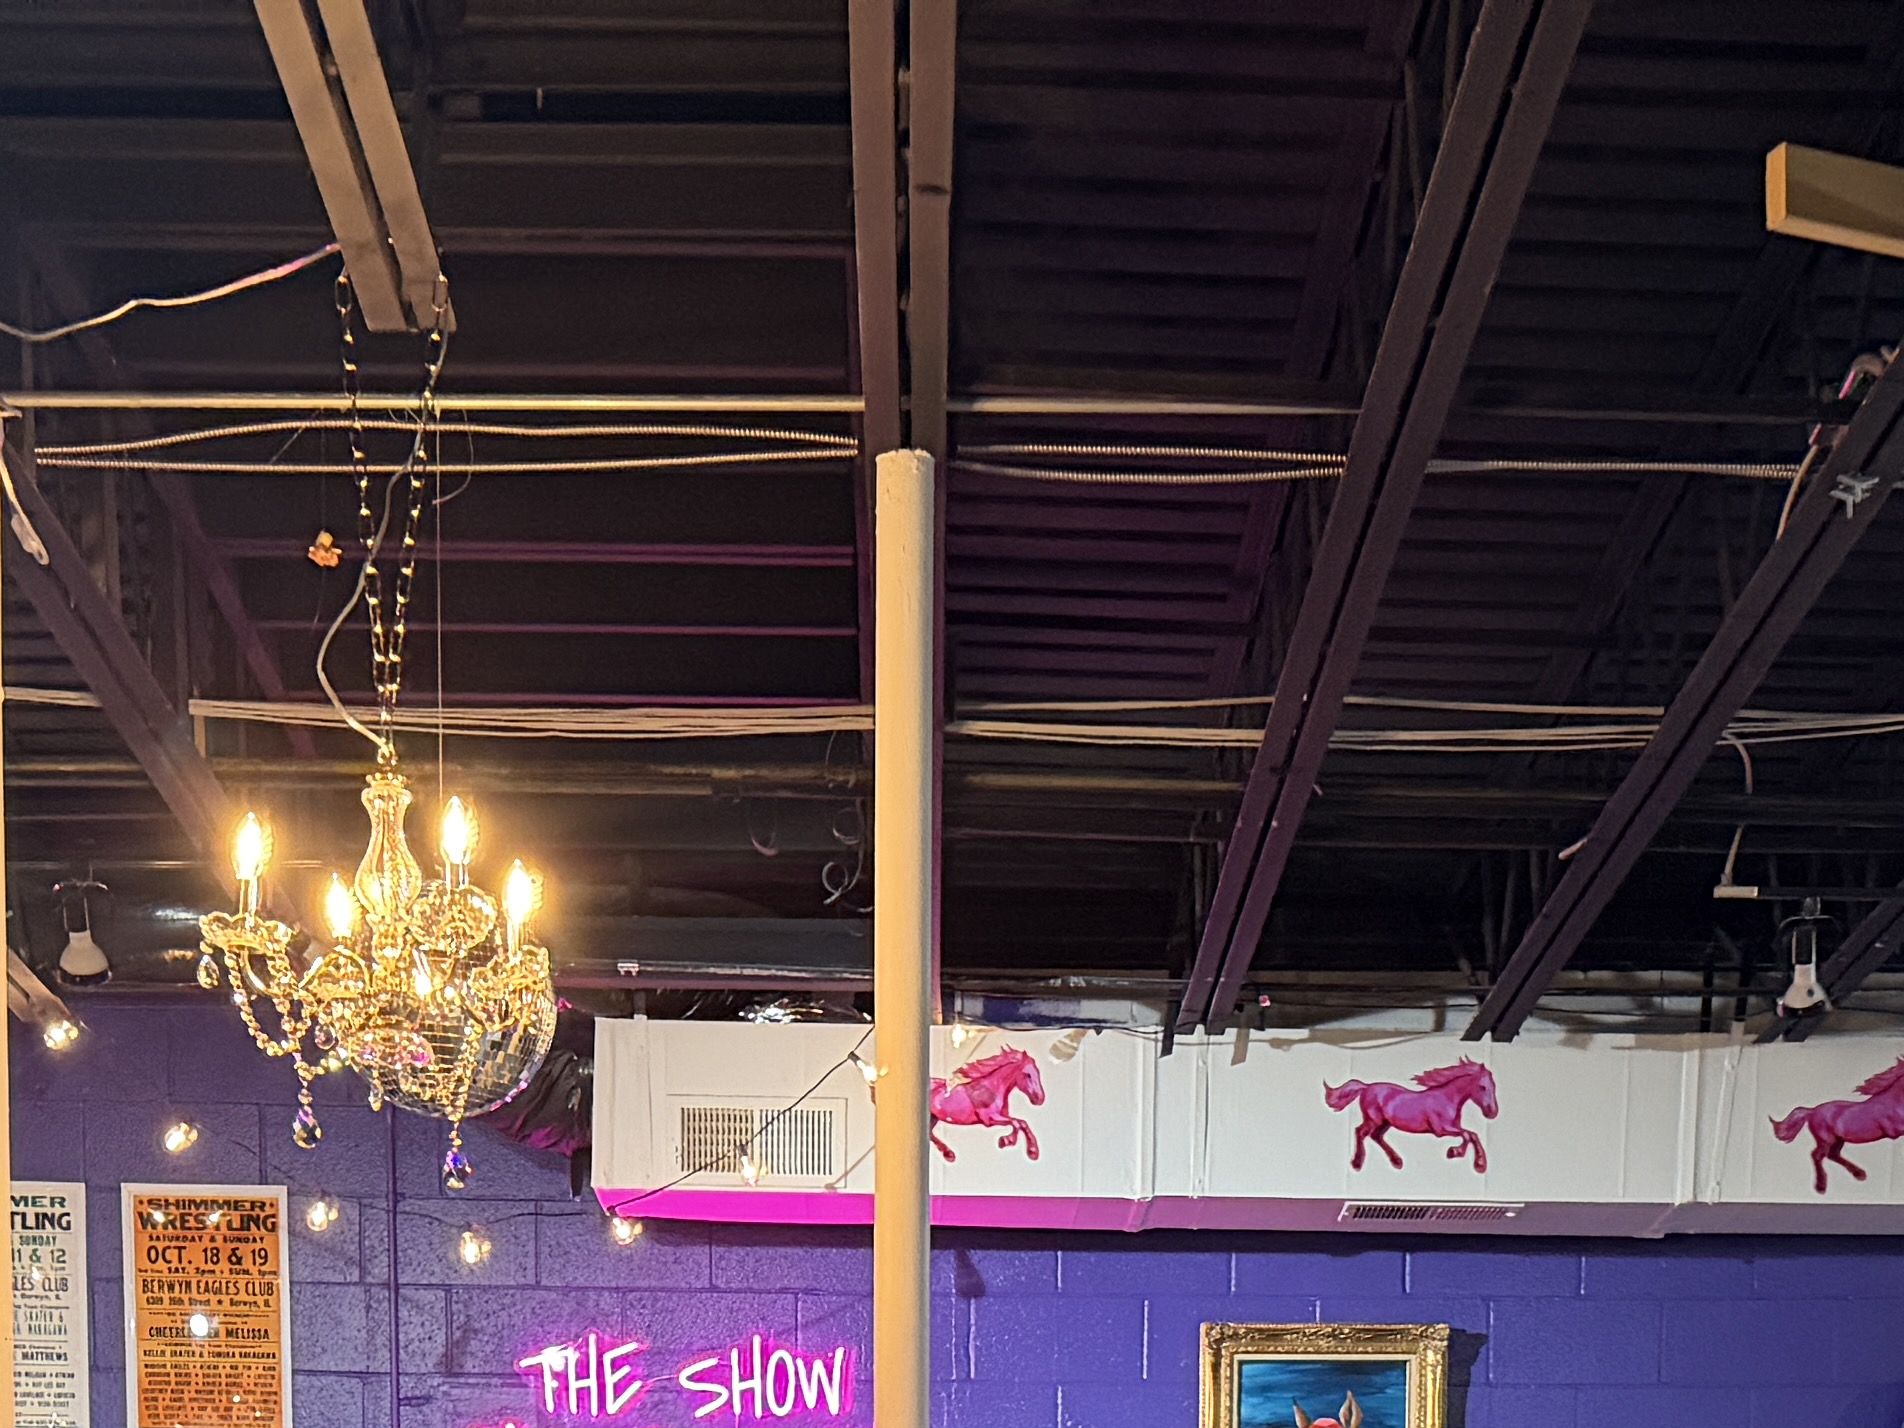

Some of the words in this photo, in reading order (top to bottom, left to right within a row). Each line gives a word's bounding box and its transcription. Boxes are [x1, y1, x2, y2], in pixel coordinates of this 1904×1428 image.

[147, 1198, 266, 1212] SHIMMER
[19, 1235, 57, 1247] SUNDAY
[148, 1234, 204, 1243] SATURDAY
[209, 1235, 217, 1243] &
[223, 1235, 265, 1244] SUNDAY
[29, 1248, 41, 1263] &
[50, 1249, 67, 1264] 12
[147, 1245, 193, 1265] OCT.
[202, 1247, 220, 1265] 18
[227, 1247, 243, 1266] &
[250, 1247, 269, 1267] 19
[42, 1277, 69, 1292] CLUB
[142, 1279, 192, 1295] BERWYN
[197, 1279, 240, 1296] EAGLES
[245, 1280, 274, 1297] CLUB
[225, 1327, 270, 1340] MELISSA
[21, 1352, 68, 1362] MATTHEWS
[518, 1333, 641, 1417] THE
[678, 1334, 845, 1419] SHOW
